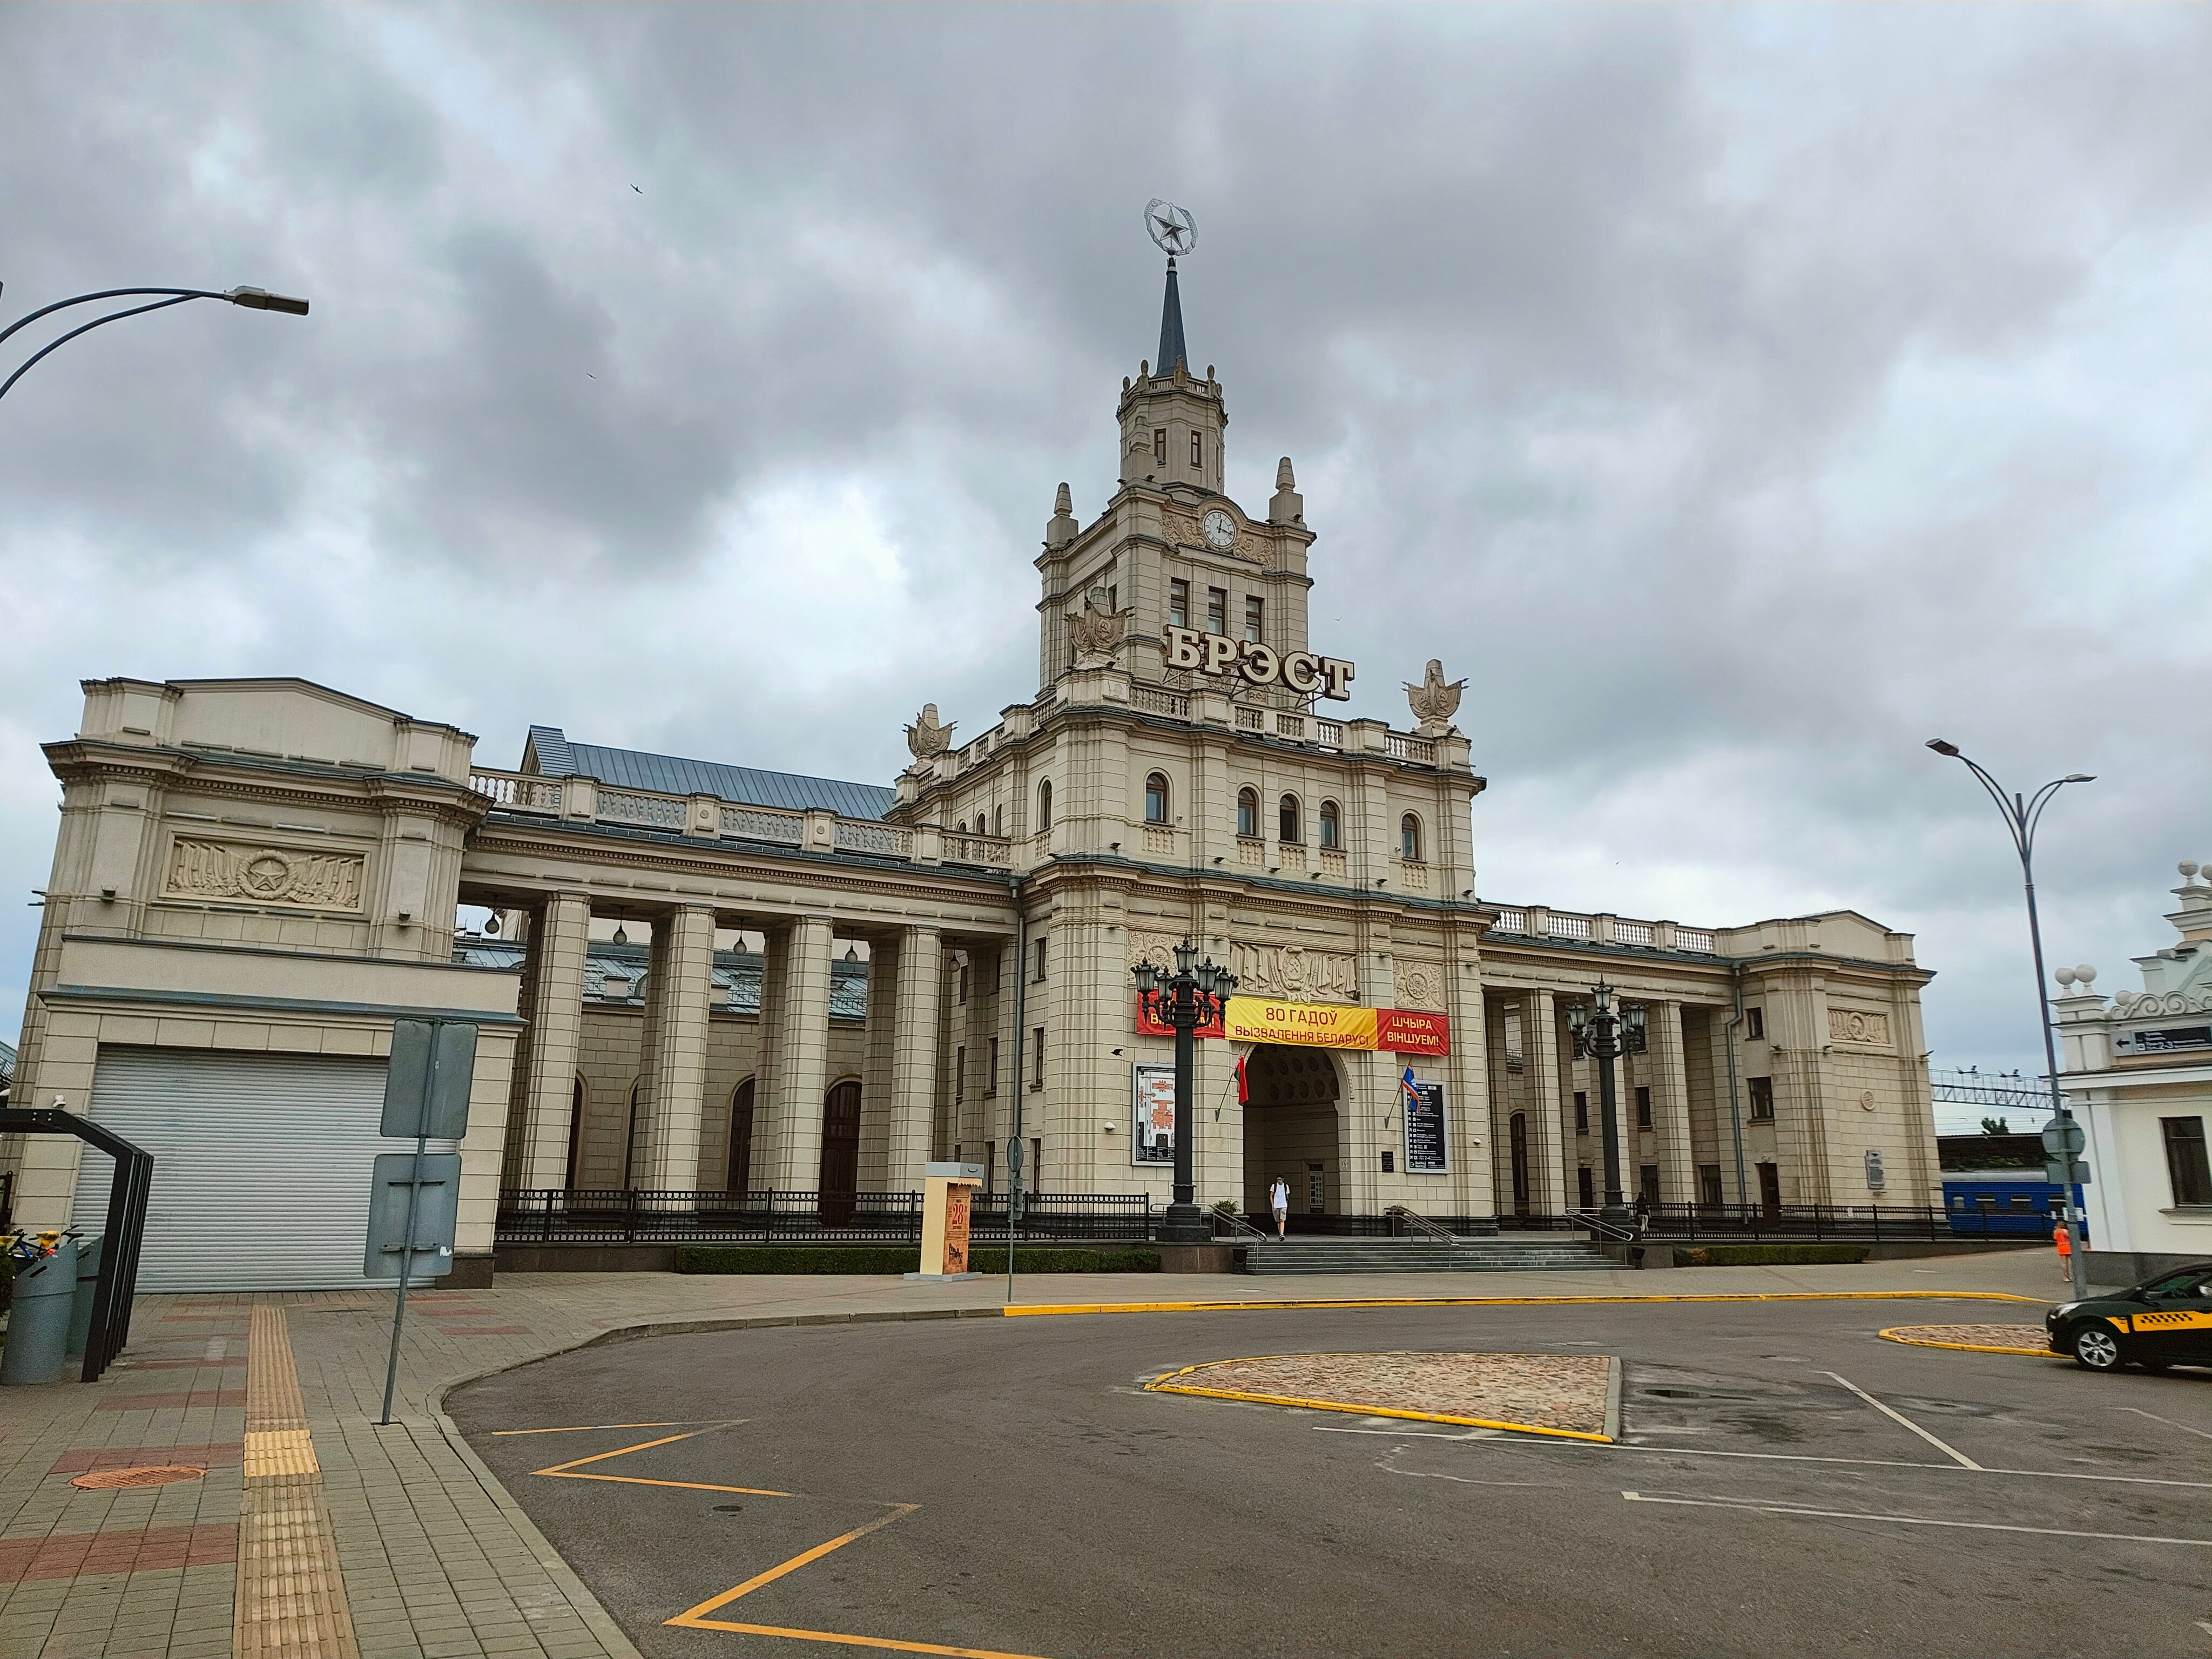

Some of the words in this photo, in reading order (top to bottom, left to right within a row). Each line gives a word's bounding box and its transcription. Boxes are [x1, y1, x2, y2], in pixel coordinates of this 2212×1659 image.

[1163, 624, 1355, 702] БРЭСТ
[1266, 1007, 1285, 1022] 80
[1290, 1009, 1338, 1027] ГАДОЎ
[1392, 1016, 1433, 1030] ШЧЫРА
[1235, 1026, 1314, 1042] ВЫЗВАЛЕННЯ
[1317, 1032, 1369, 1046] БЕЛАРУСІ
[1387, 1031, 1439, 1046] ВІНШУЕМ!
[952, 1204, 964, 1225] 28
